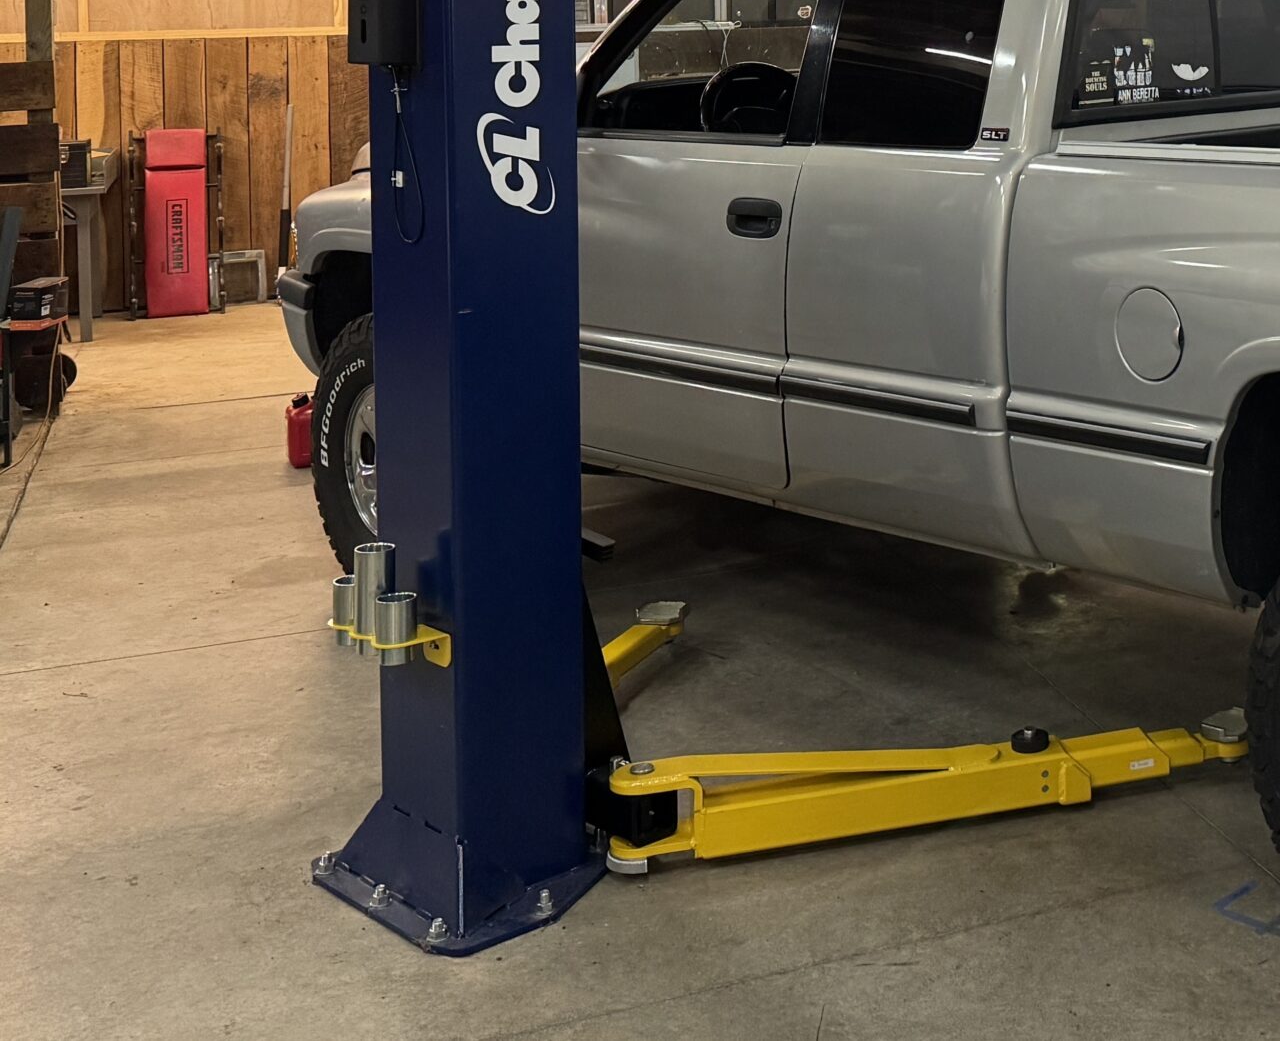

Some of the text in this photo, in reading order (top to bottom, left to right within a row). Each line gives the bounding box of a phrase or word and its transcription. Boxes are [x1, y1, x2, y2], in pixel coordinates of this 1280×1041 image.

[1085, 82, 1108, 92] SOULS
[982, 130, 1007, 140] SLT
[171, 203, 184, 270] CRAFTSMAN
[320, 357, 366, 468] BFGoodrich
